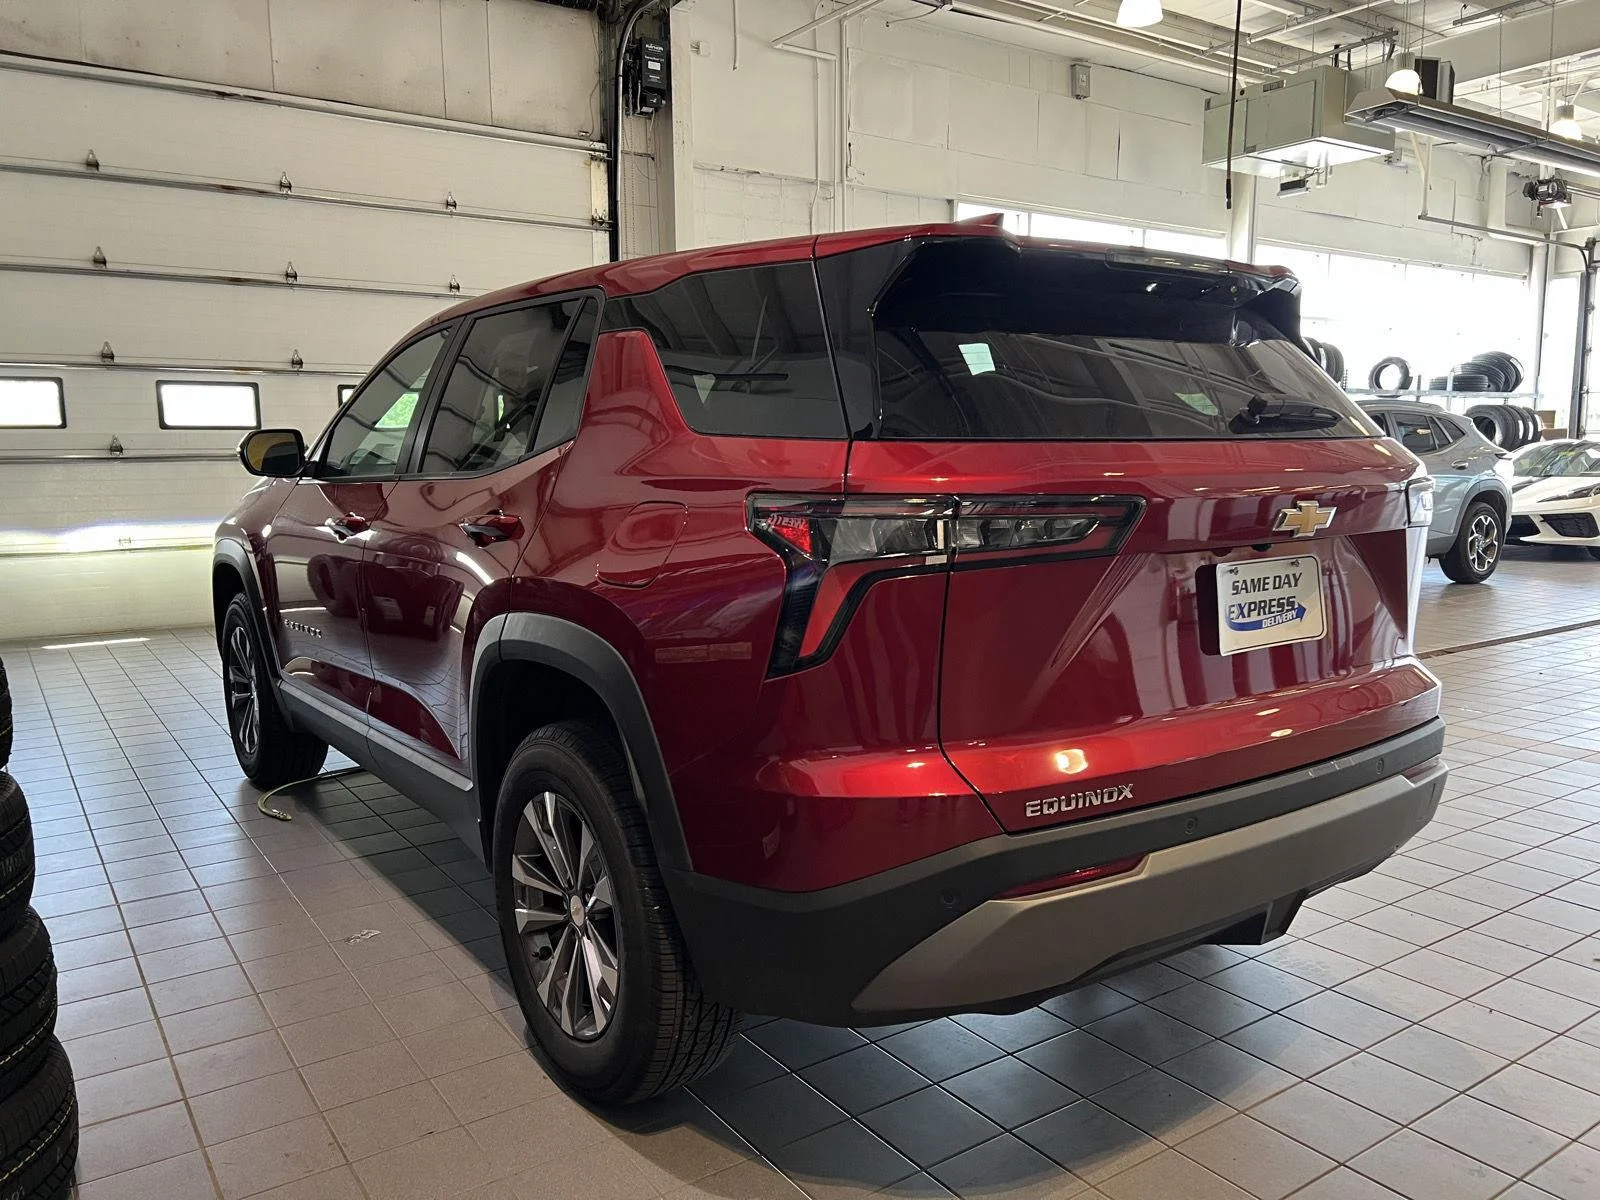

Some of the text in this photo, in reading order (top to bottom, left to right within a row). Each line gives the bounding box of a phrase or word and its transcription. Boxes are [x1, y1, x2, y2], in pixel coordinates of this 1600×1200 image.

[1231, 572, 1302, 596] SAME DAY
[1227, 595, 1296, 621] EXPRESS
[1262, 610, 1298, 628] DELIVERY
[1025, 783, 1134, 817] EQUINOX
